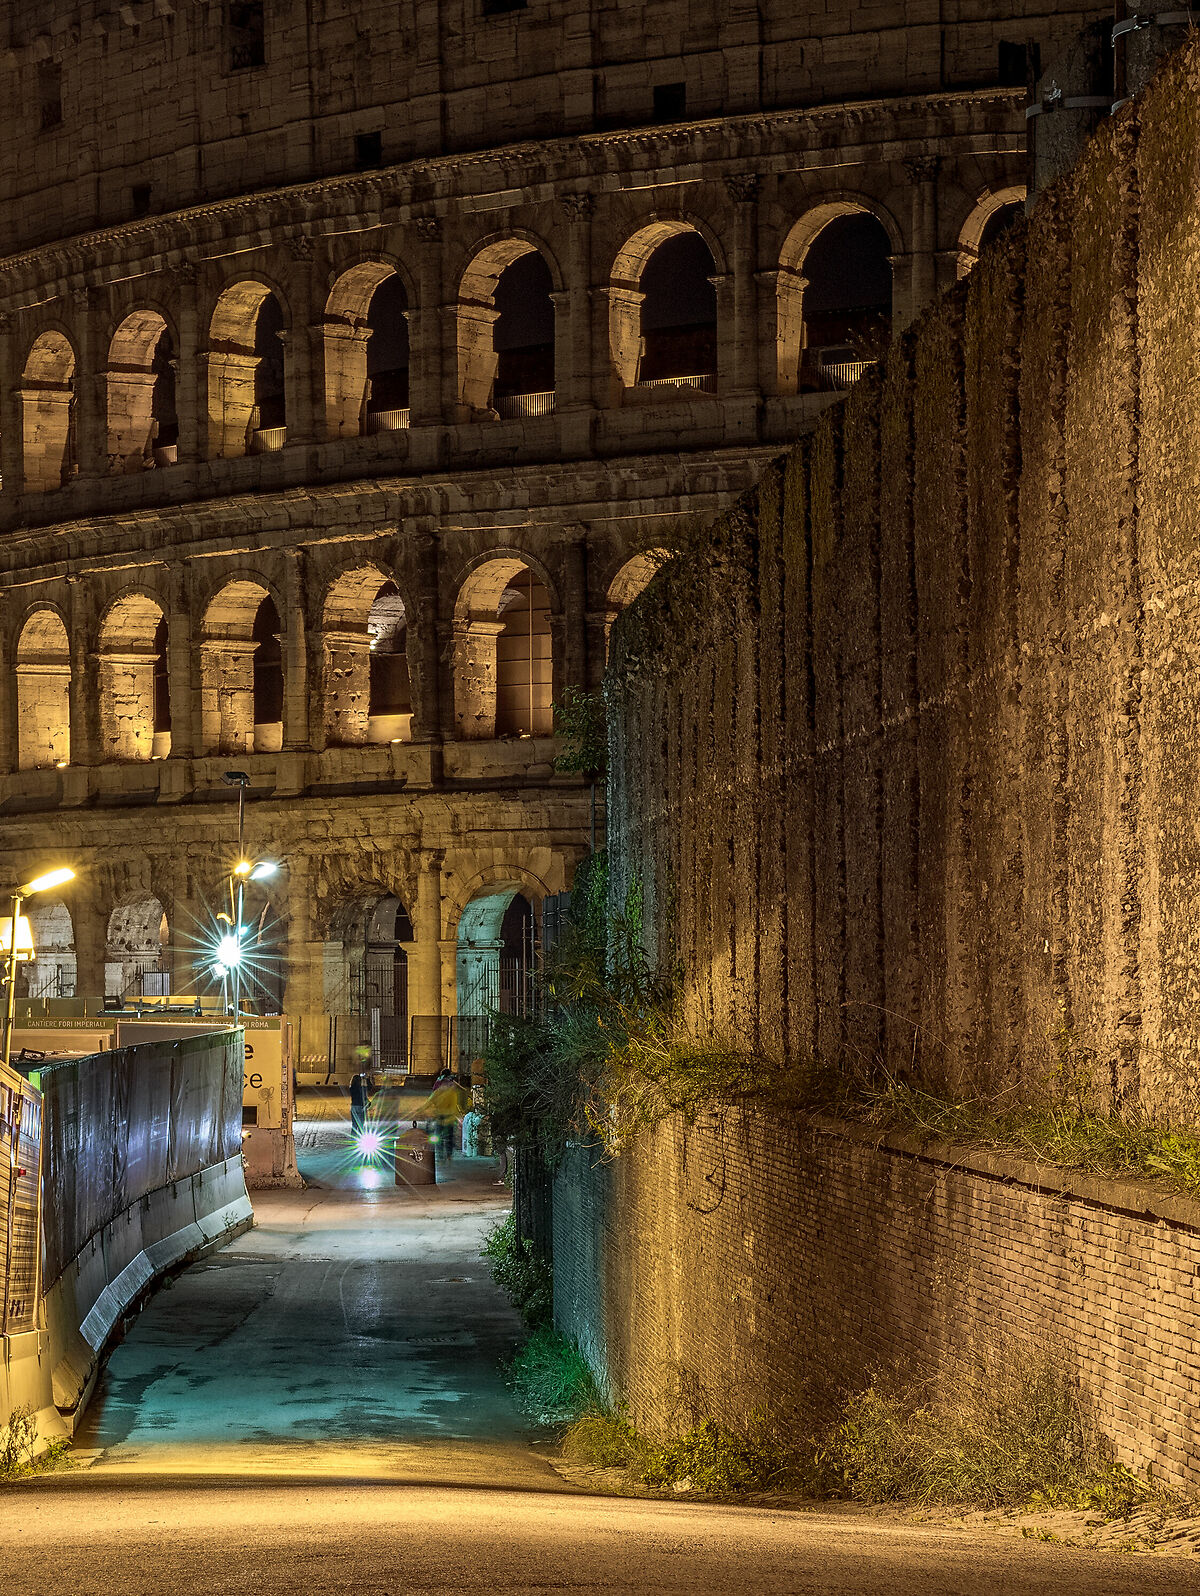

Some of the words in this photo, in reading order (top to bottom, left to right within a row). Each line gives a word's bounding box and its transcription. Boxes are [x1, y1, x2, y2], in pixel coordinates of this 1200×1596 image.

[27, 1020, 58, 1028] CANTIERE
[58, 1020, 74, 1028] FORI
[74, 1020, 106, 1028] IMPERIALI
